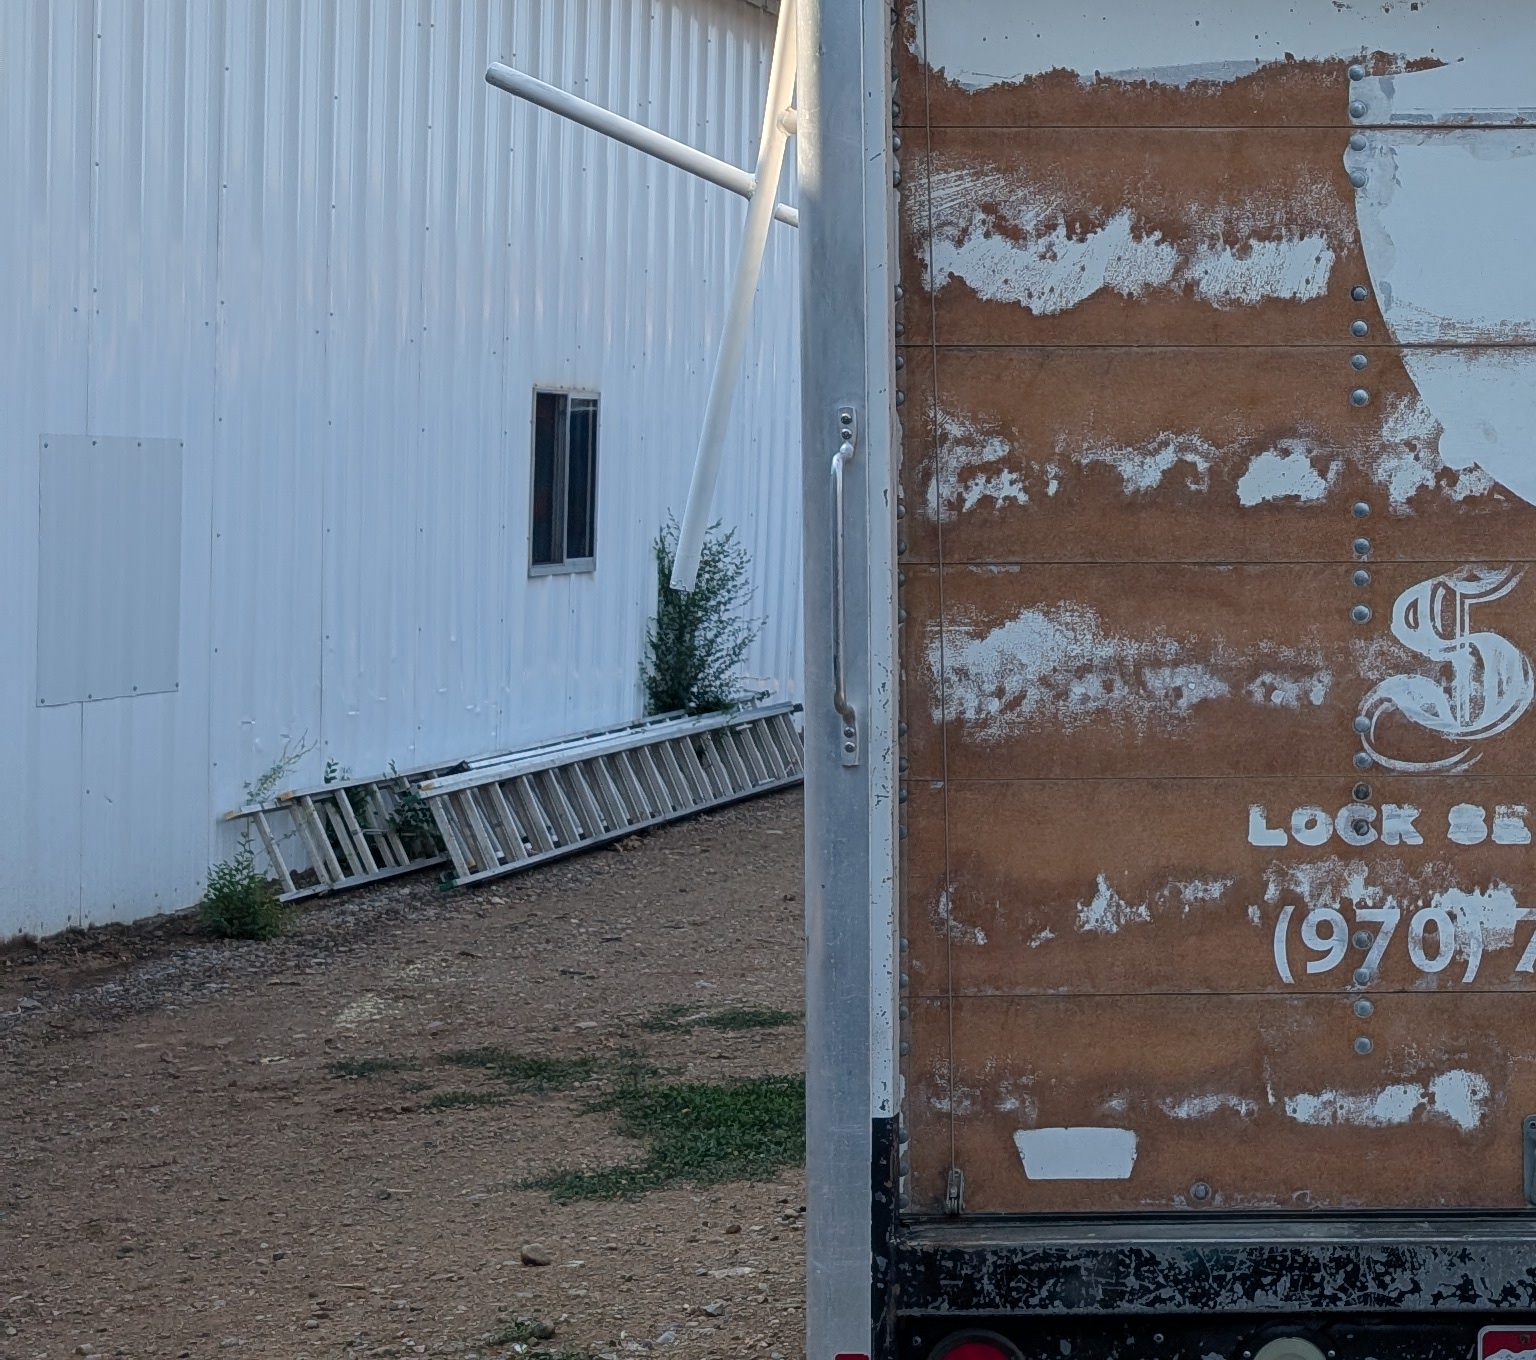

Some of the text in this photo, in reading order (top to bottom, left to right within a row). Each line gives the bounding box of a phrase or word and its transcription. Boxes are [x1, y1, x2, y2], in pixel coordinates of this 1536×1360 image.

[1356, 563, 1535, 773] S
[1247, 803, 1424, 847] LOCK
[1273, 904, 1480, 984] (970)
